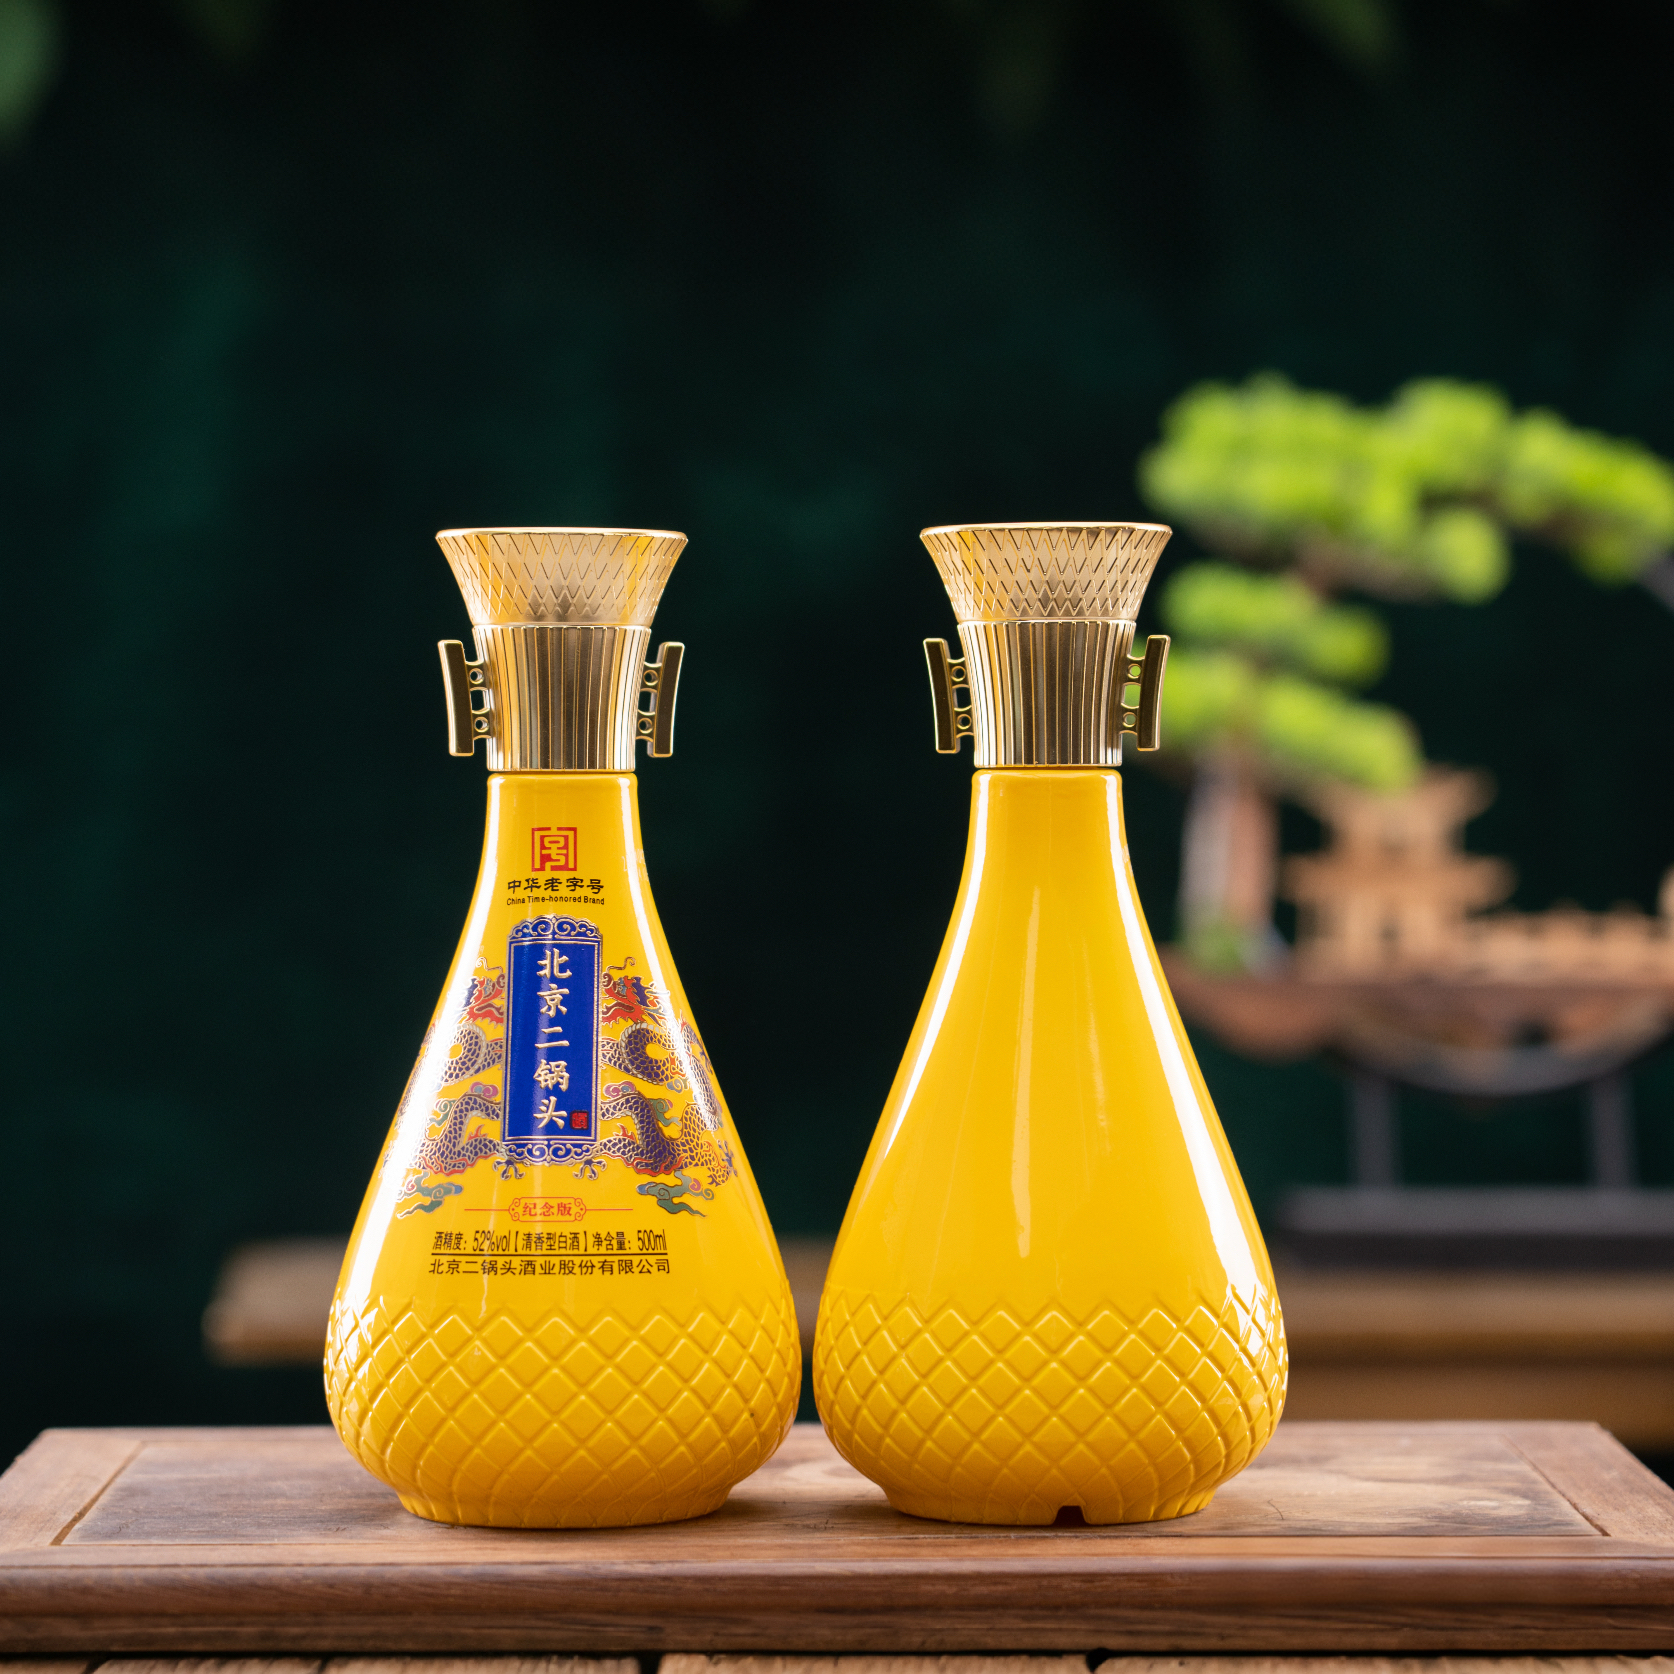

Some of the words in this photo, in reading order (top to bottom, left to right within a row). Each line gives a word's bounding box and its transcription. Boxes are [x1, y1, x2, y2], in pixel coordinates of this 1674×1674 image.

[507, 877, 604, 894] 中华老字号
[506, 897, 526, 906] China
[527, 895, 582, 904] Time-honored
[583, 895, 605, 905] Brand
[533, 948, 573, 1130] 北京二锅头
[522, 1202, 573, 1217] 纪念版
[428, 1258, 671, 1276] 北京二锅头酒业股份有限公司
